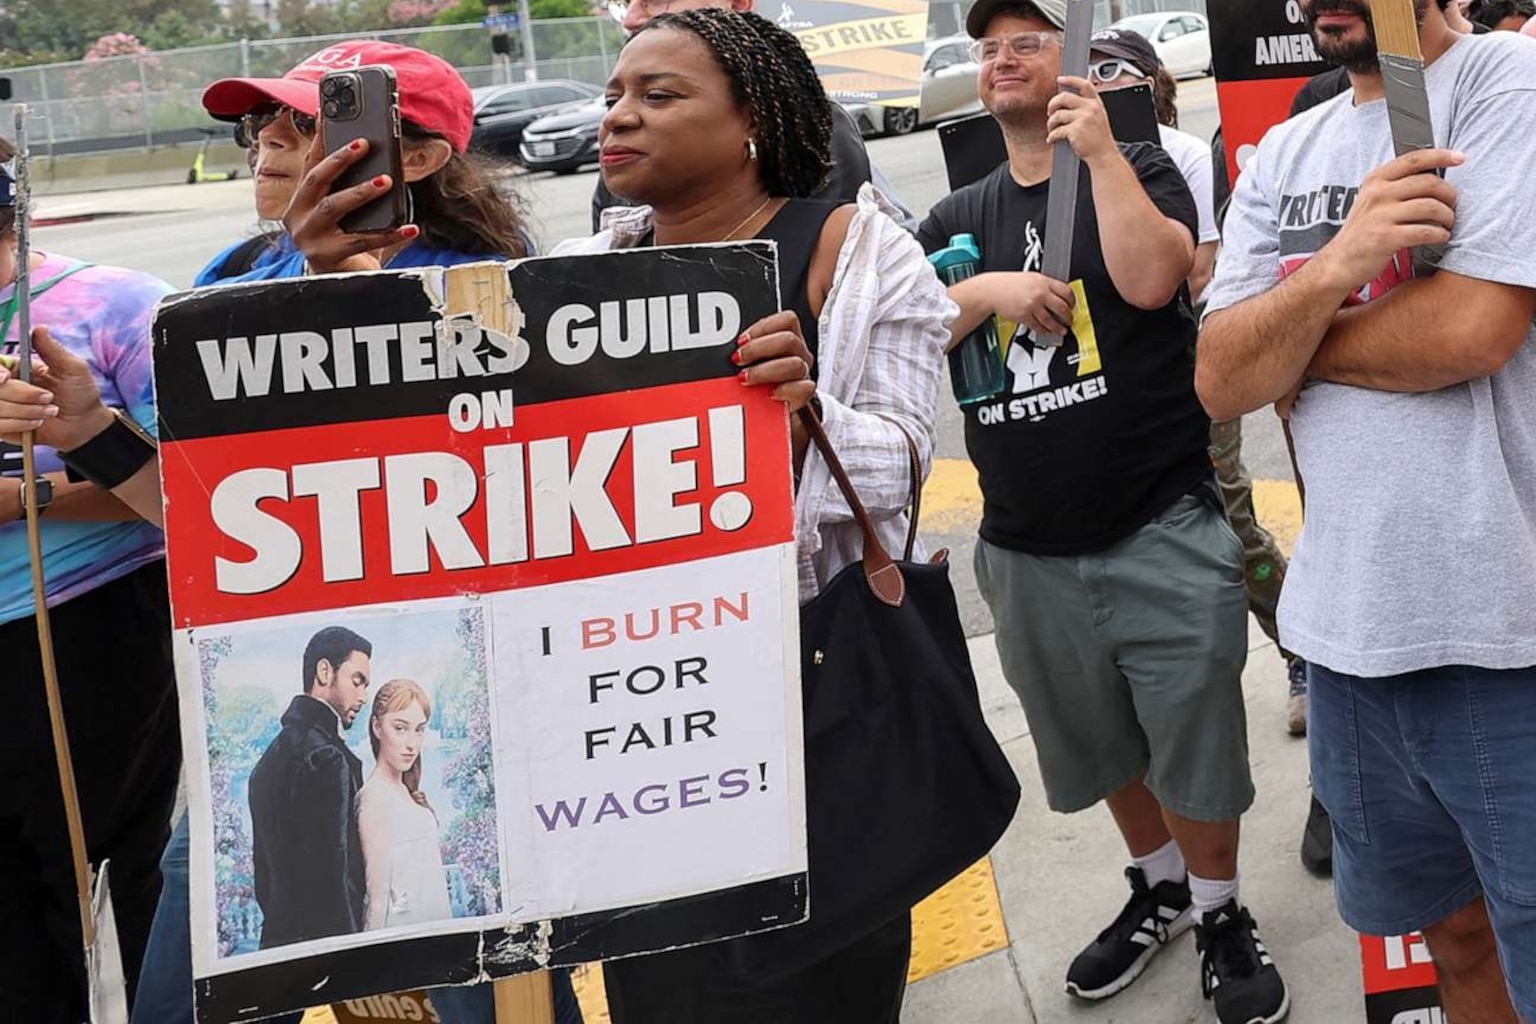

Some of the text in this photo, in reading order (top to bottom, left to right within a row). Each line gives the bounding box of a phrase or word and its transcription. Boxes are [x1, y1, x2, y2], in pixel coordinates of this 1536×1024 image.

[800, 20, 913, 53] STRIKE
[1255, 33, 1323, 66] AMER
[196, 291, 742, 401] WRITERS GUILD
[448, 389, 515, 433] ON
[977, 375, 1108, 426] ON STRIKE!
[209, 404, 755, 596] STRIKE!
[540, 591, 751, 656] I BURN
[588, 656, 709, 705] FOR
[584, 710, 719, 760] FAIR
[534, 762, 771, 833] WAGES!
